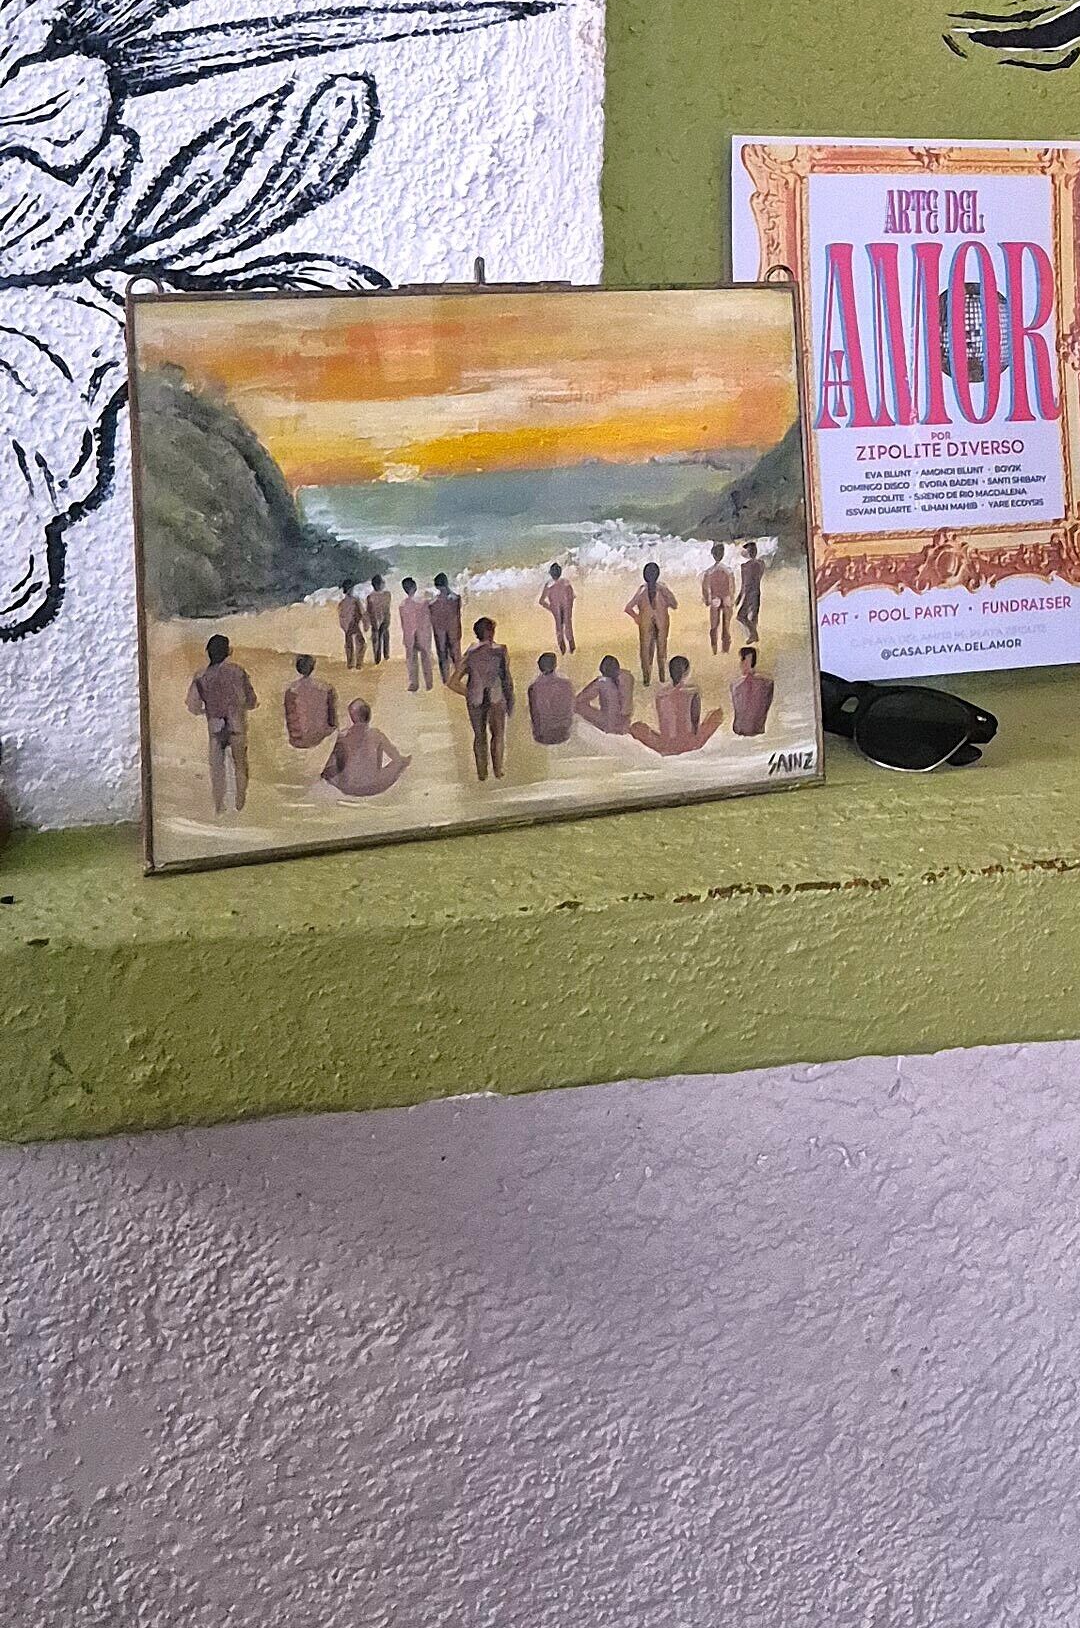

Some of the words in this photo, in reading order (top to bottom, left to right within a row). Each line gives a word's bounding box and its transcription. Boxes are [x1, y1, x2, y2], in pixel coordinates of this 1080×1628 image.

[884, 190, 939, 234] ARTE
[944, 190, 985, 234] DEL
[813, 241, 1061, 429] AMOR
[931, 432, 951, 441] POR
[856, 442, 941, 461] ZIPOLITE
[947, 439, 1025, 457] DIVERSO
[865, 470, 883, 479] EVA
[884, 469, 912, 479] BLUNT
[956, 465, 984, 476] BLUNT
[884, 481, 910, 491] DISCO
[987, 476, 1012, 486] SANTI
[946, 490, 957, 499] DE
[959, 489, 974, 499] RIO
[878, 504, 912, 515] DUARTE
[820, 611, 849, 627] ART
[868, 607, 911, 623] POOL
[914, 603, 960, 619] PARTY
[982, 595, 1072, 615] FUNDRAISER
